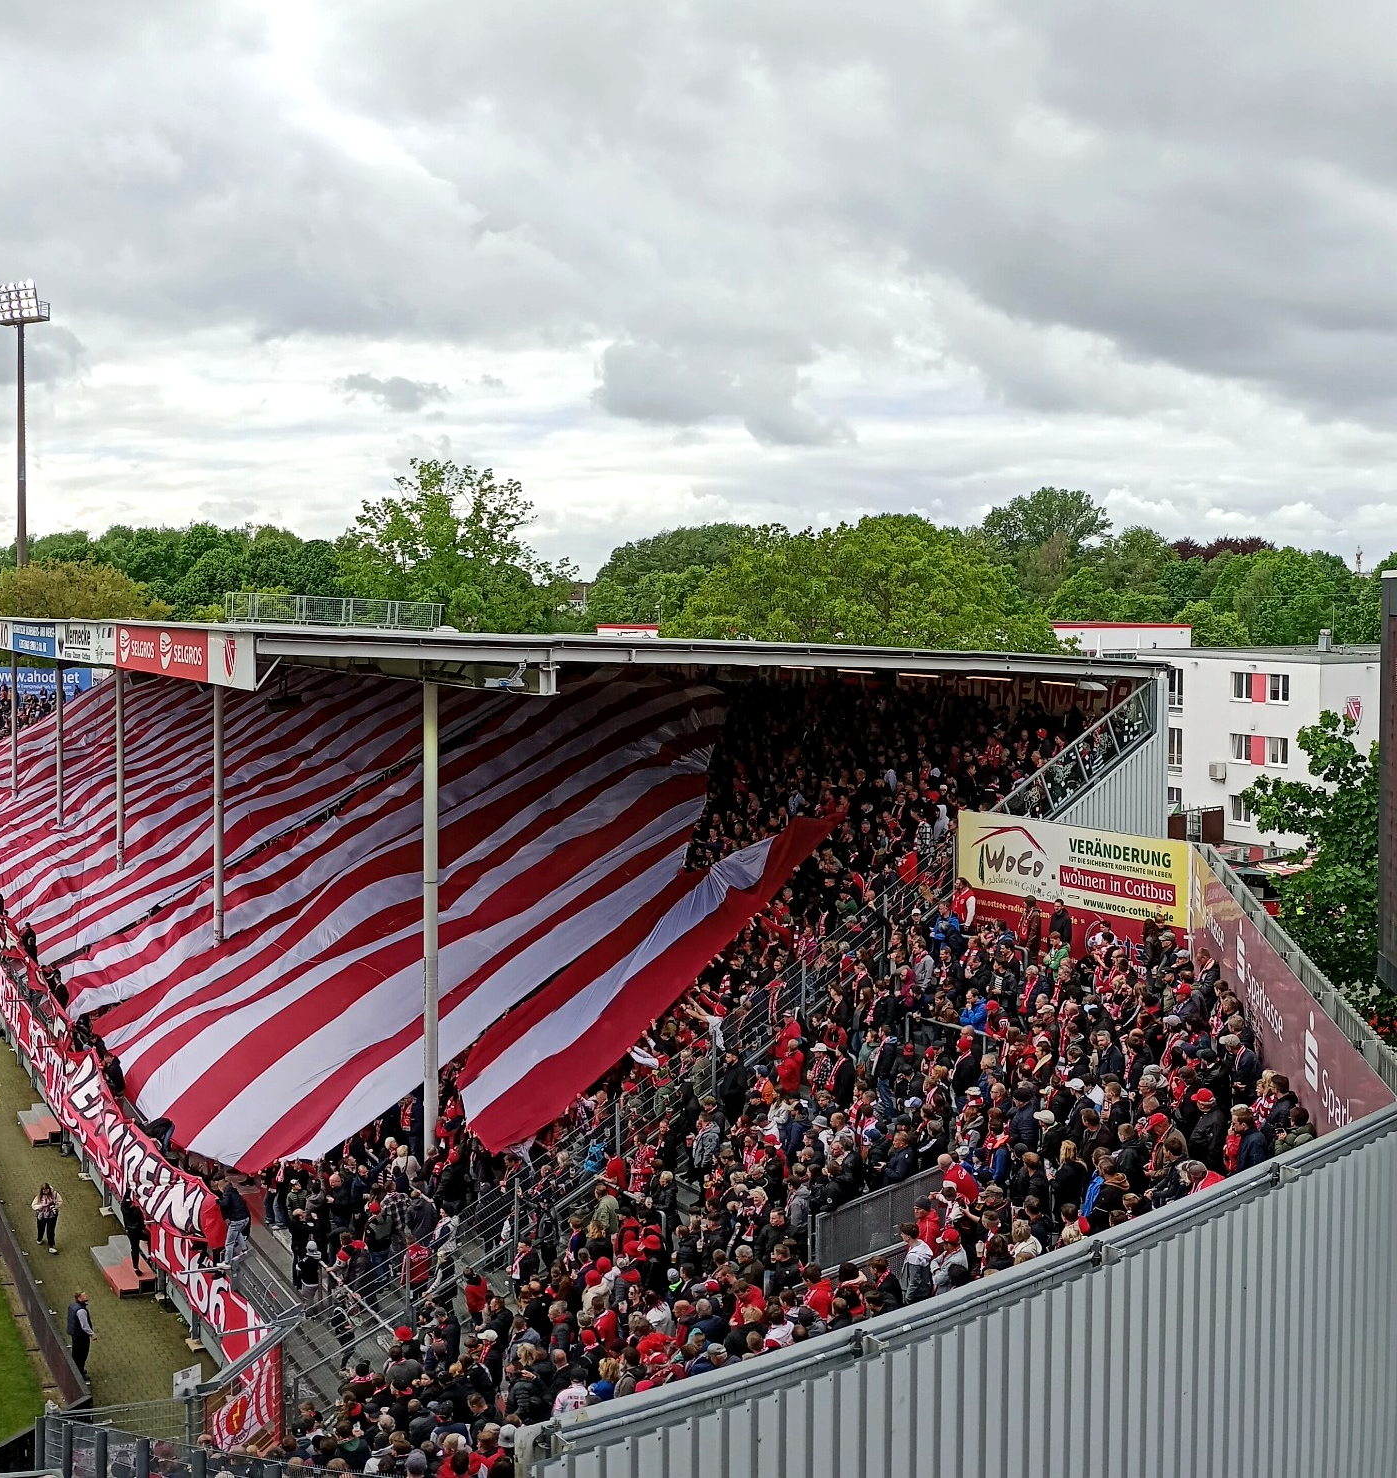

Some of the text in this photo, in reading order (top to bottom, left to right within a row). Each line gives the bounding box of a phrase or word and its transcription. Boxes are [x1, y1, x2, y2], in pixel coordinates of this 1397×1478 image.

[65, 625, 91, 646] Wernecke
[131, 639, 155, 658] SELGROS
[173, 644, 202, 666] SELGROS
[985, 844, 1044, 878] WoCo
[1069, 838, 1171, 868] VERÄNDERUNG
[1086, 858, 1114, 869] SICHERSTE
[1115, 863, 1146, 875] KONSTANTE
[1154, 870, 1172, 879] LEBEN
[1062, 868, 1173, 902] wohnen in Cottbus
[1083, 898, 1174, 922] www.woco-cottbude
[1247, 962, 1283, 1042] Sparkasse
